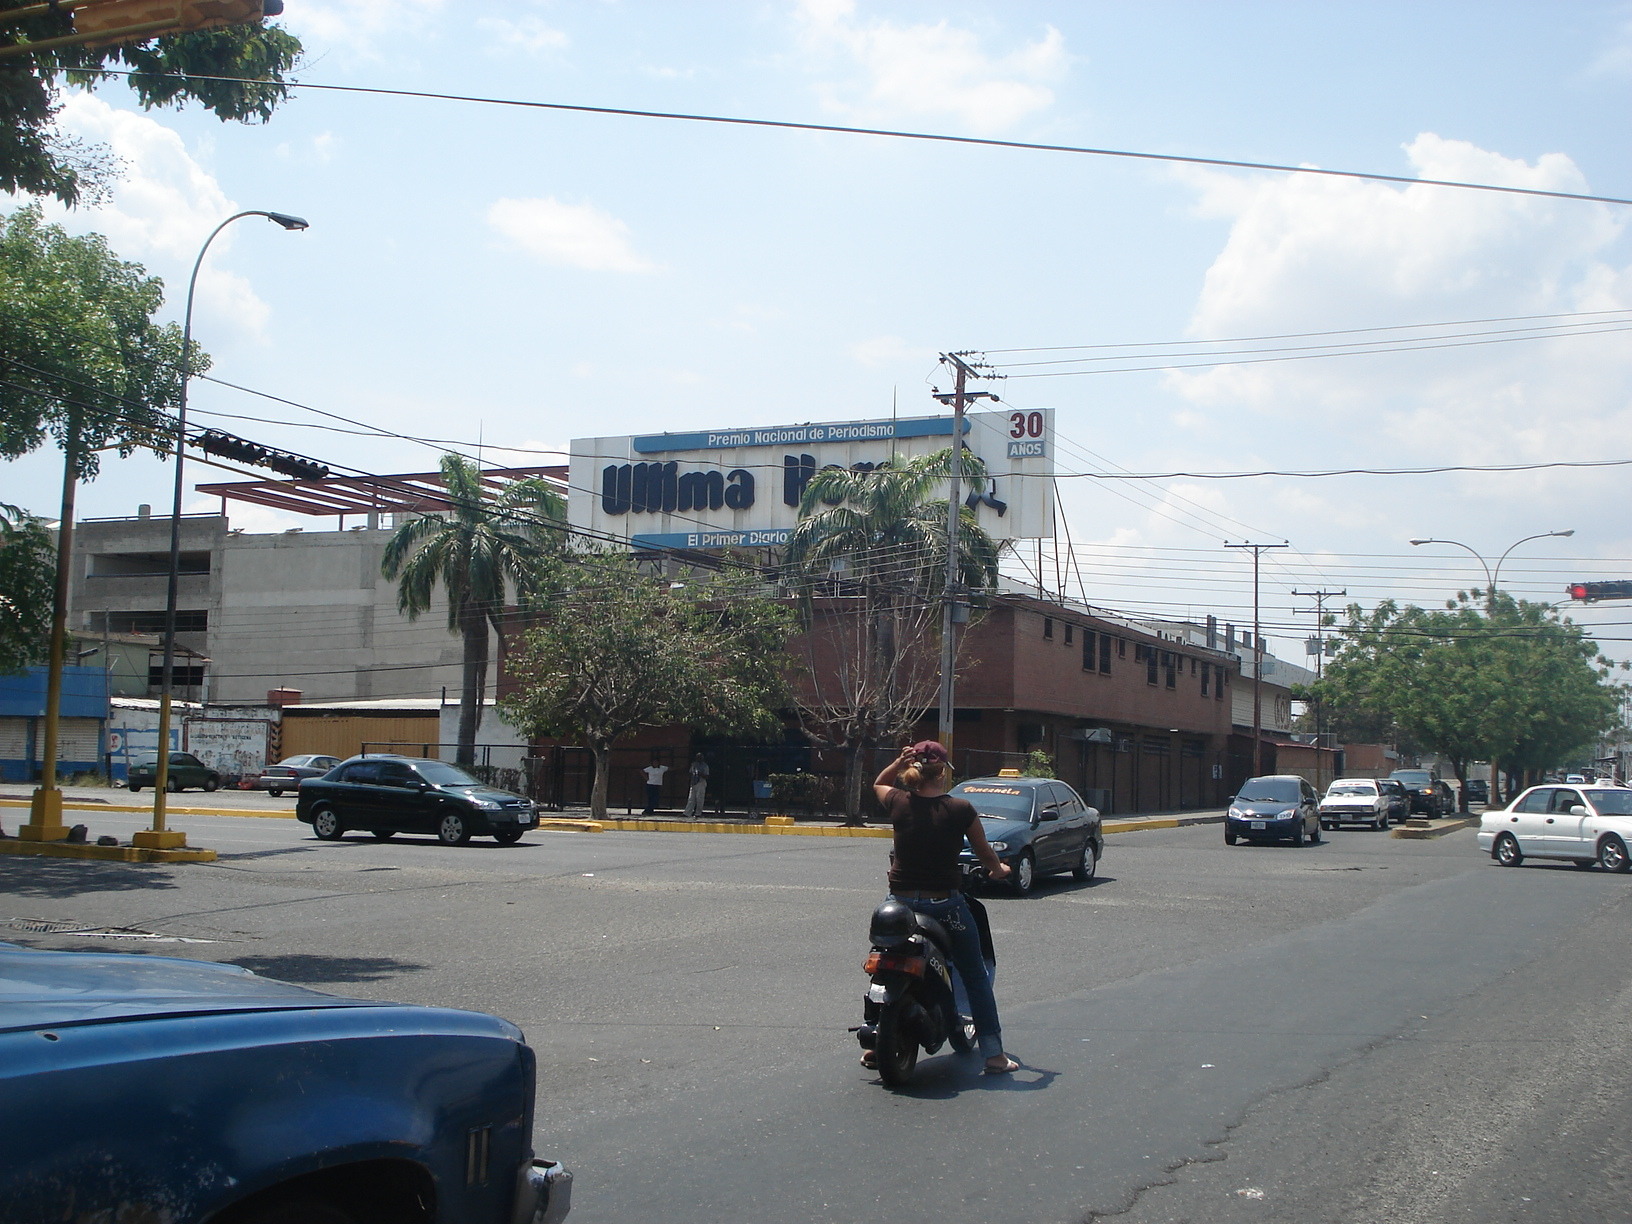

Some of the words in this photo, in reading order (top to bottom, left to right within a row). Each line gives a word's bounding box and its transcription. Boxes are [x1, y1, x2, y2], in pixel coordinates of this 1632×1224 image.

[1010, 412, 1043, 438] 30
[708, 433, 750, 446] Premio
[754, 428, 807, 443] Nacional
[809, 427, 824, 440] de
[828, 424, 895, 439] Periodismo
[1010, 442, 1042, 456] AÑOS
[687, 534, 698, 547] El
[702, 533, 746, 546] Primer
[749, 531, 788, 544] Diario
